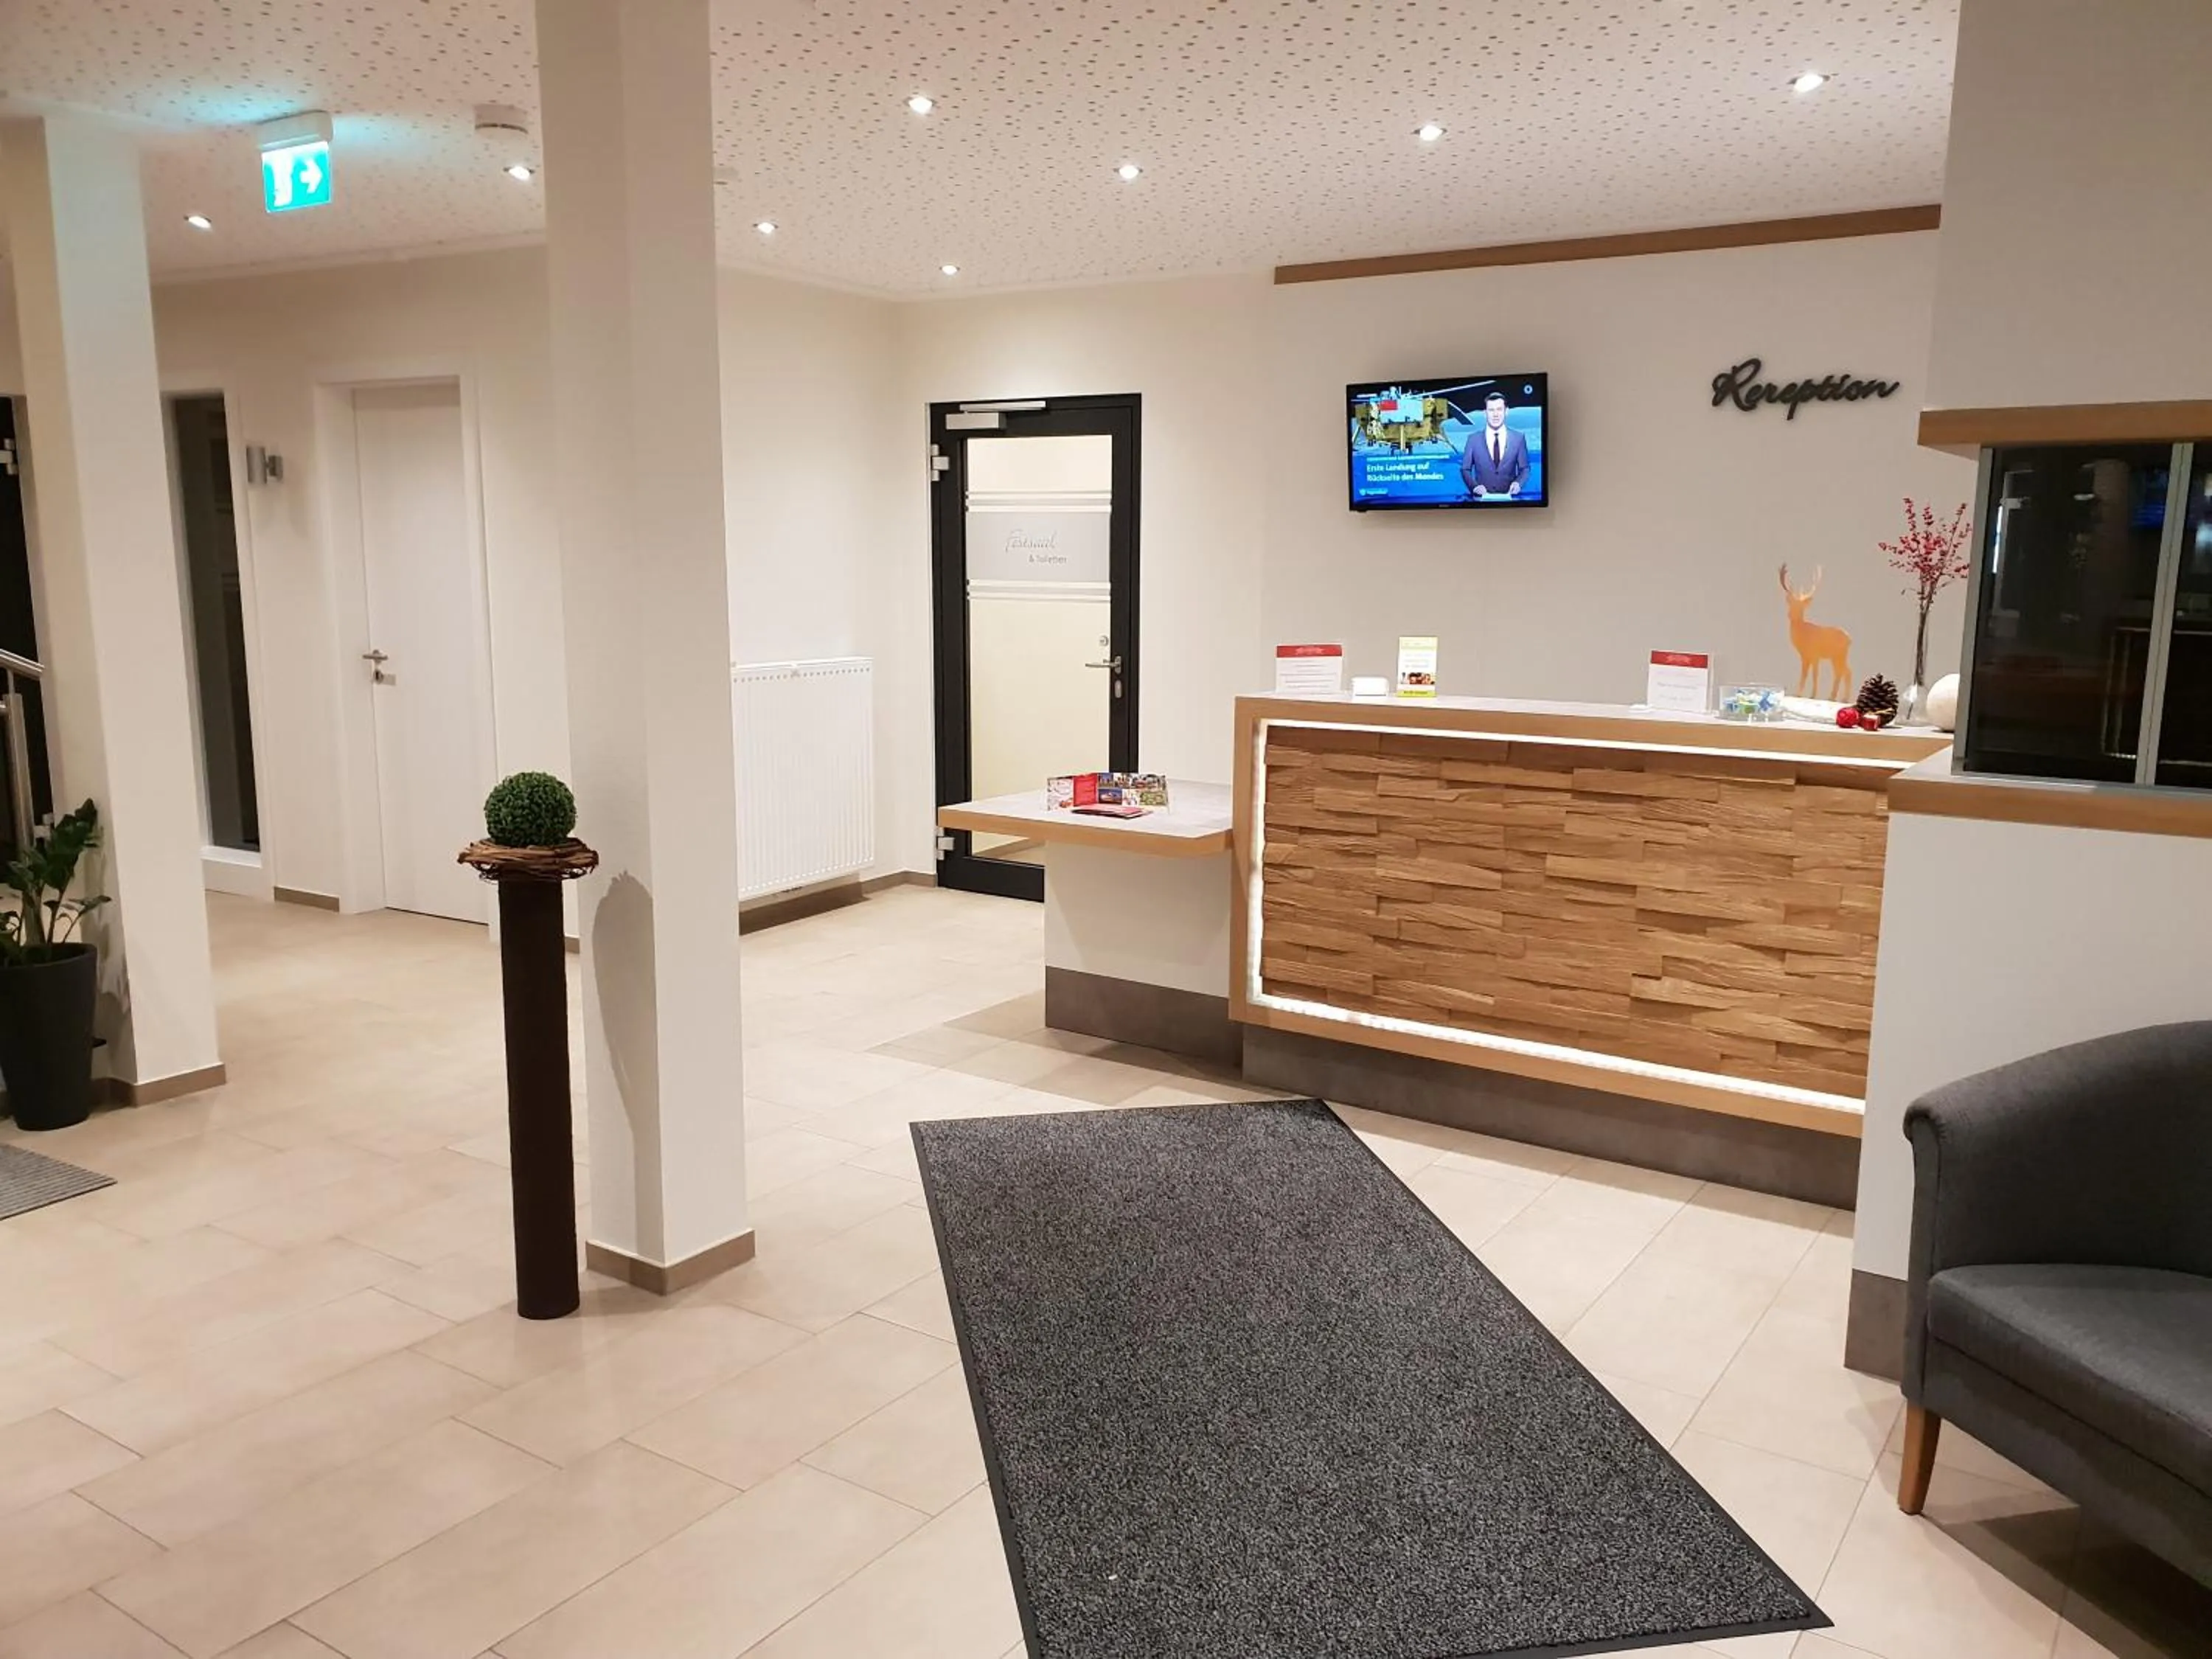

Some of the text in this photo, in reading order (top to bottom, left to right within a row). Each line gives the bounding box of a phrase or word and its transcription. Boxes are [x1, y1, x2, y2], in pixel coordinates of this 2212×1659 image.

[1711, 358, 1900, 420] Reception
[1366, 462, 1430, 473] Erste Landung auf
[1401, 473, 1414, 481] des
[1415, 472, 1444, 480] Mondes
